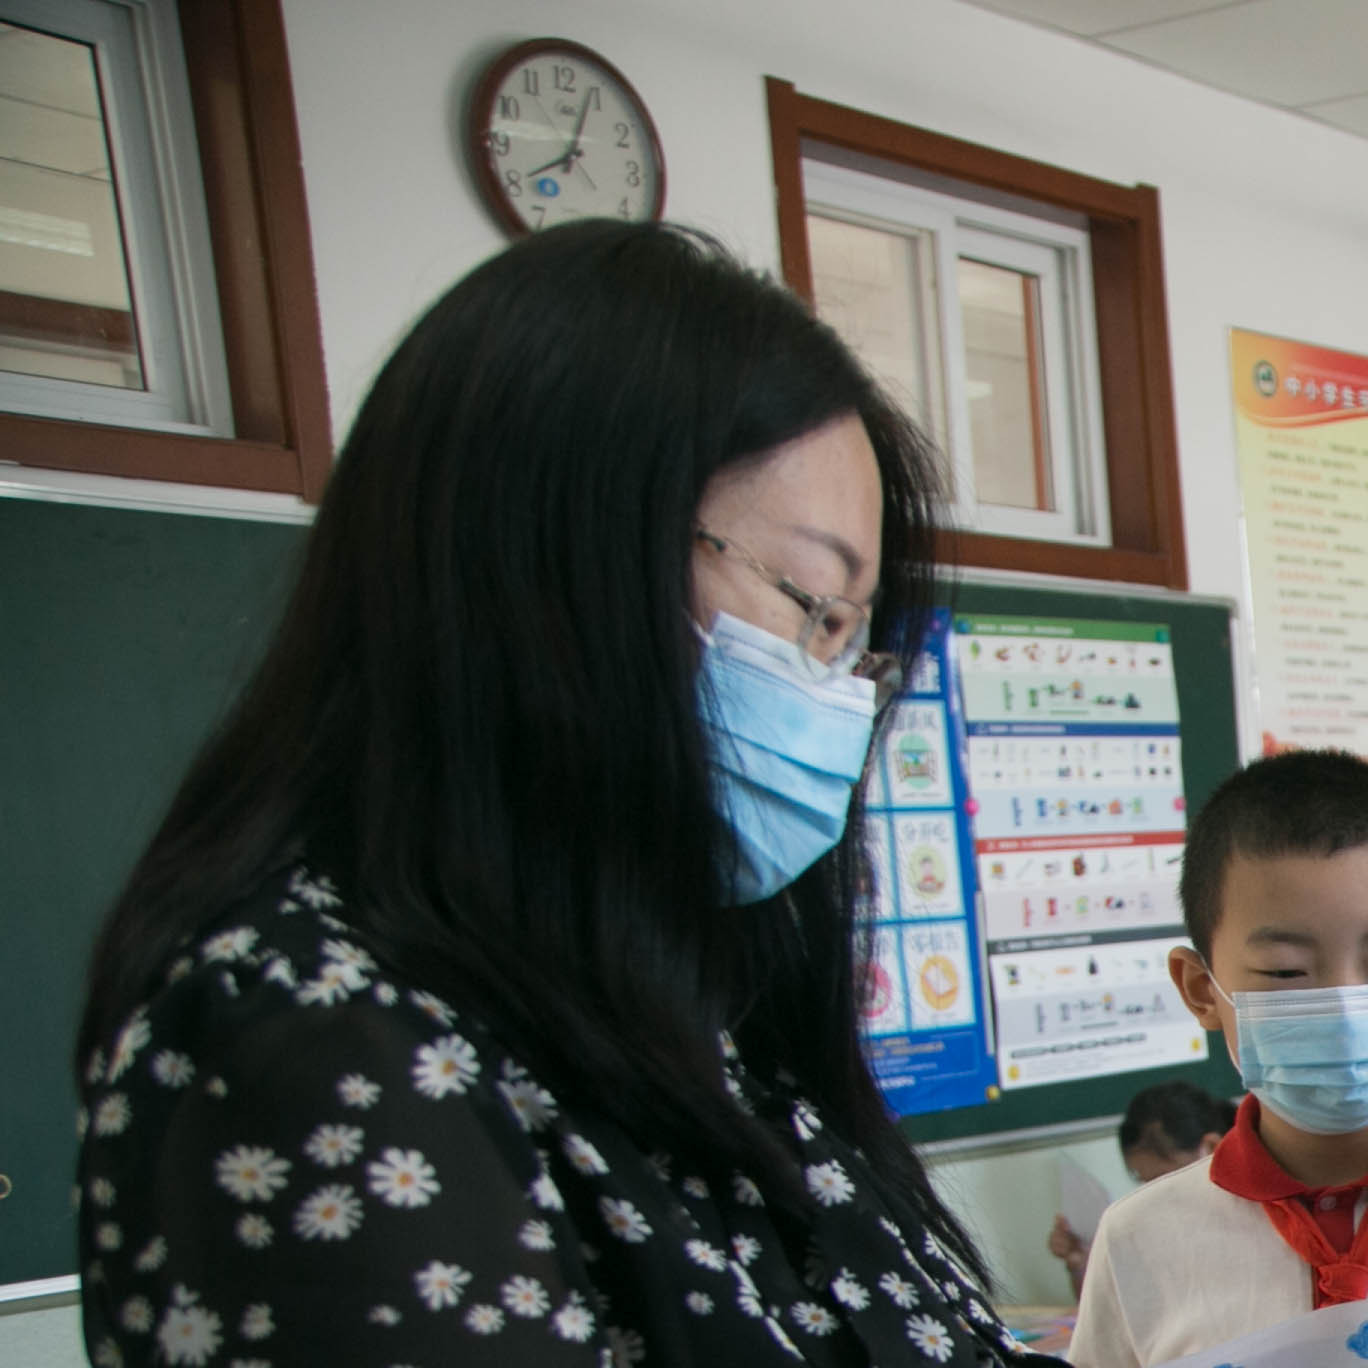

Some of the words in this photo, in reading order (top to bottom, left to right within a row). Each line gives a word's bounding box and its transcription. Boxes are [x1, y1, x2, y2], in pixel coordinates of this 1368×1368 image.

[524, 68, 540, 96] 11
[553, 66, 576, 93] 12
[501, 95, 519, 121] 10
[615, 122, 631, 149] 2
[506, 169, 522, 198] 8
[626, 160, 640, 188] 3
[531, 204, 546, 231] 7
